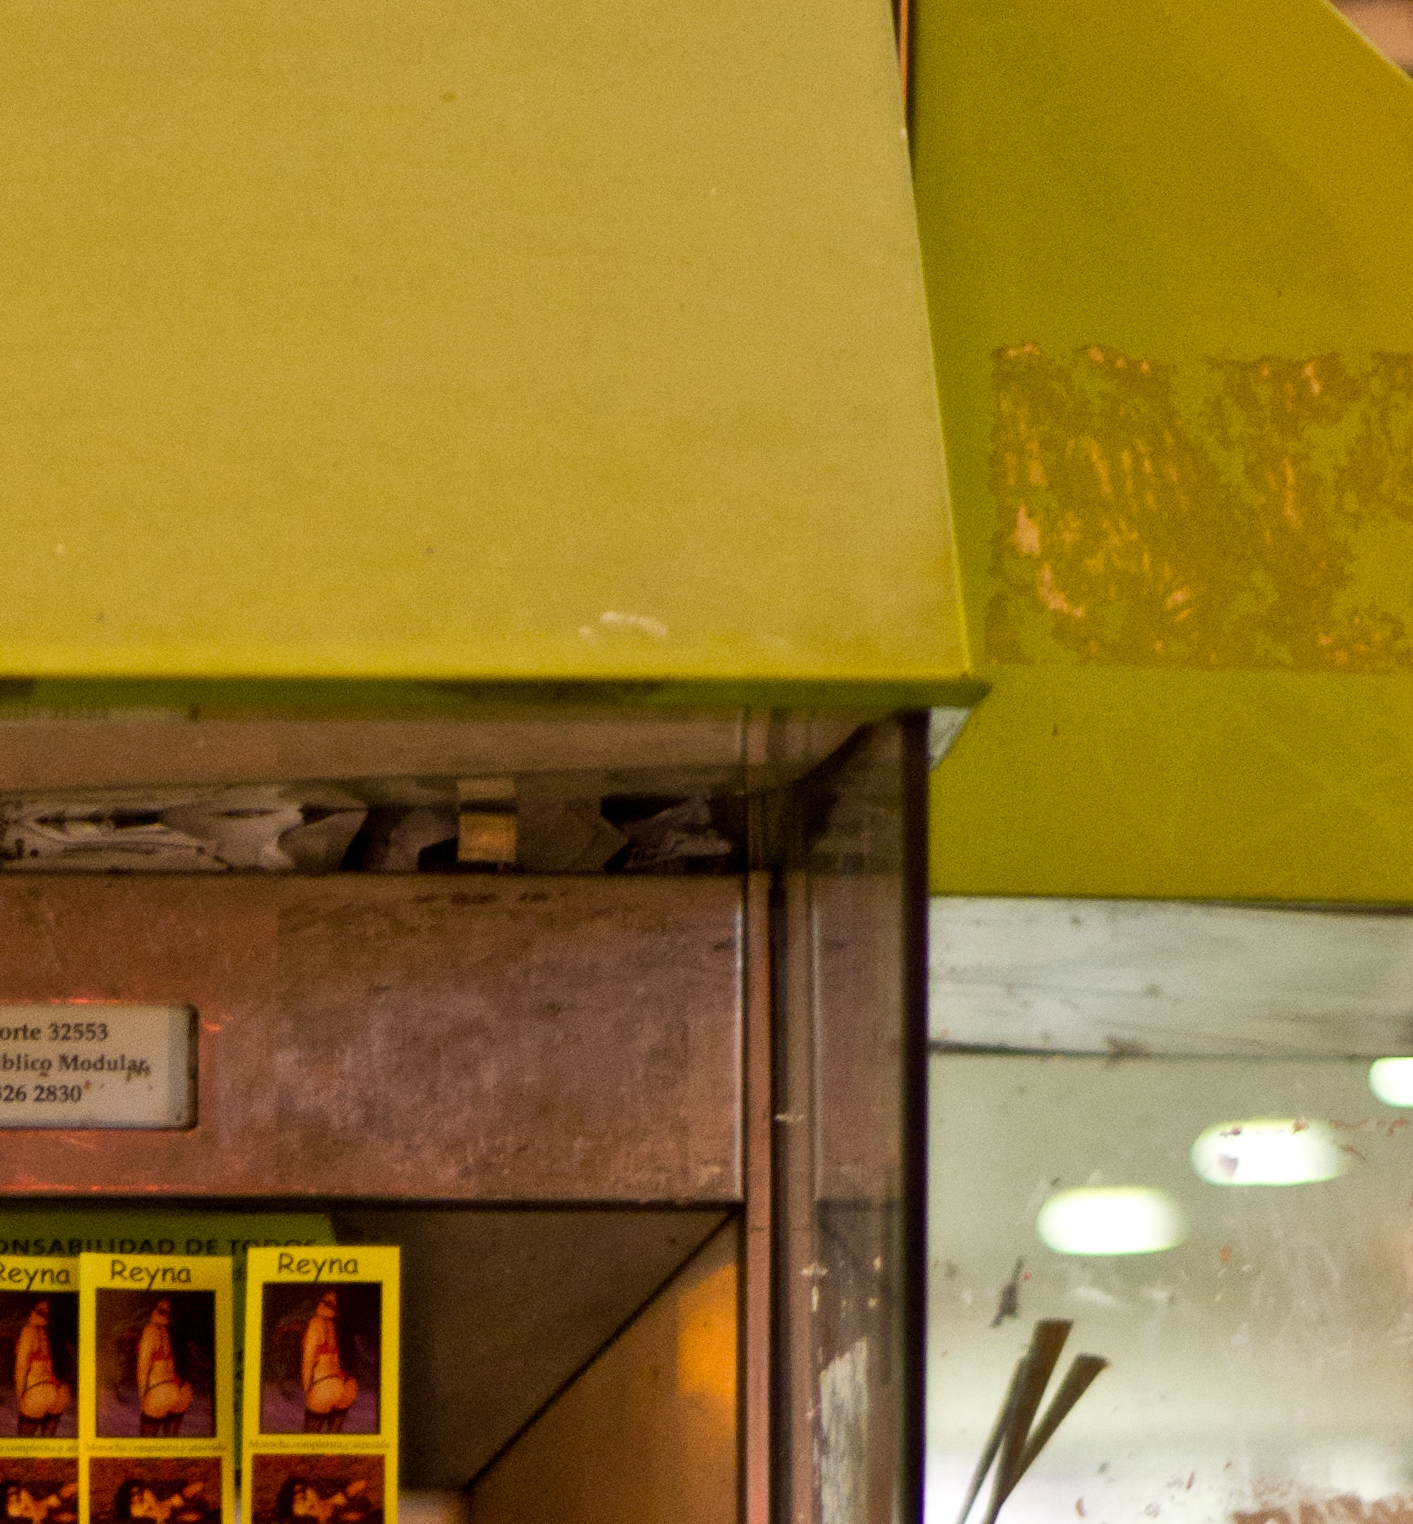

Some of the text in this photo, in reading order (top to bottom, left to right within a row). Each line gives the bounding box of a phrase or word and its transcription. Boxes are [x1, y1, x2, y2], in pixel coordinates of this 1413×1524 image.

[48, 1022, 108, 1040] 32553
[59, 1052, 147, 1071] Modular
[34, 1084, 82, 1102] 2830
[186, 1239, 211, 1255] DE
[110, 1259, 192, 1291] Reyna
[277, 1252, 359, 1282] Reyna
